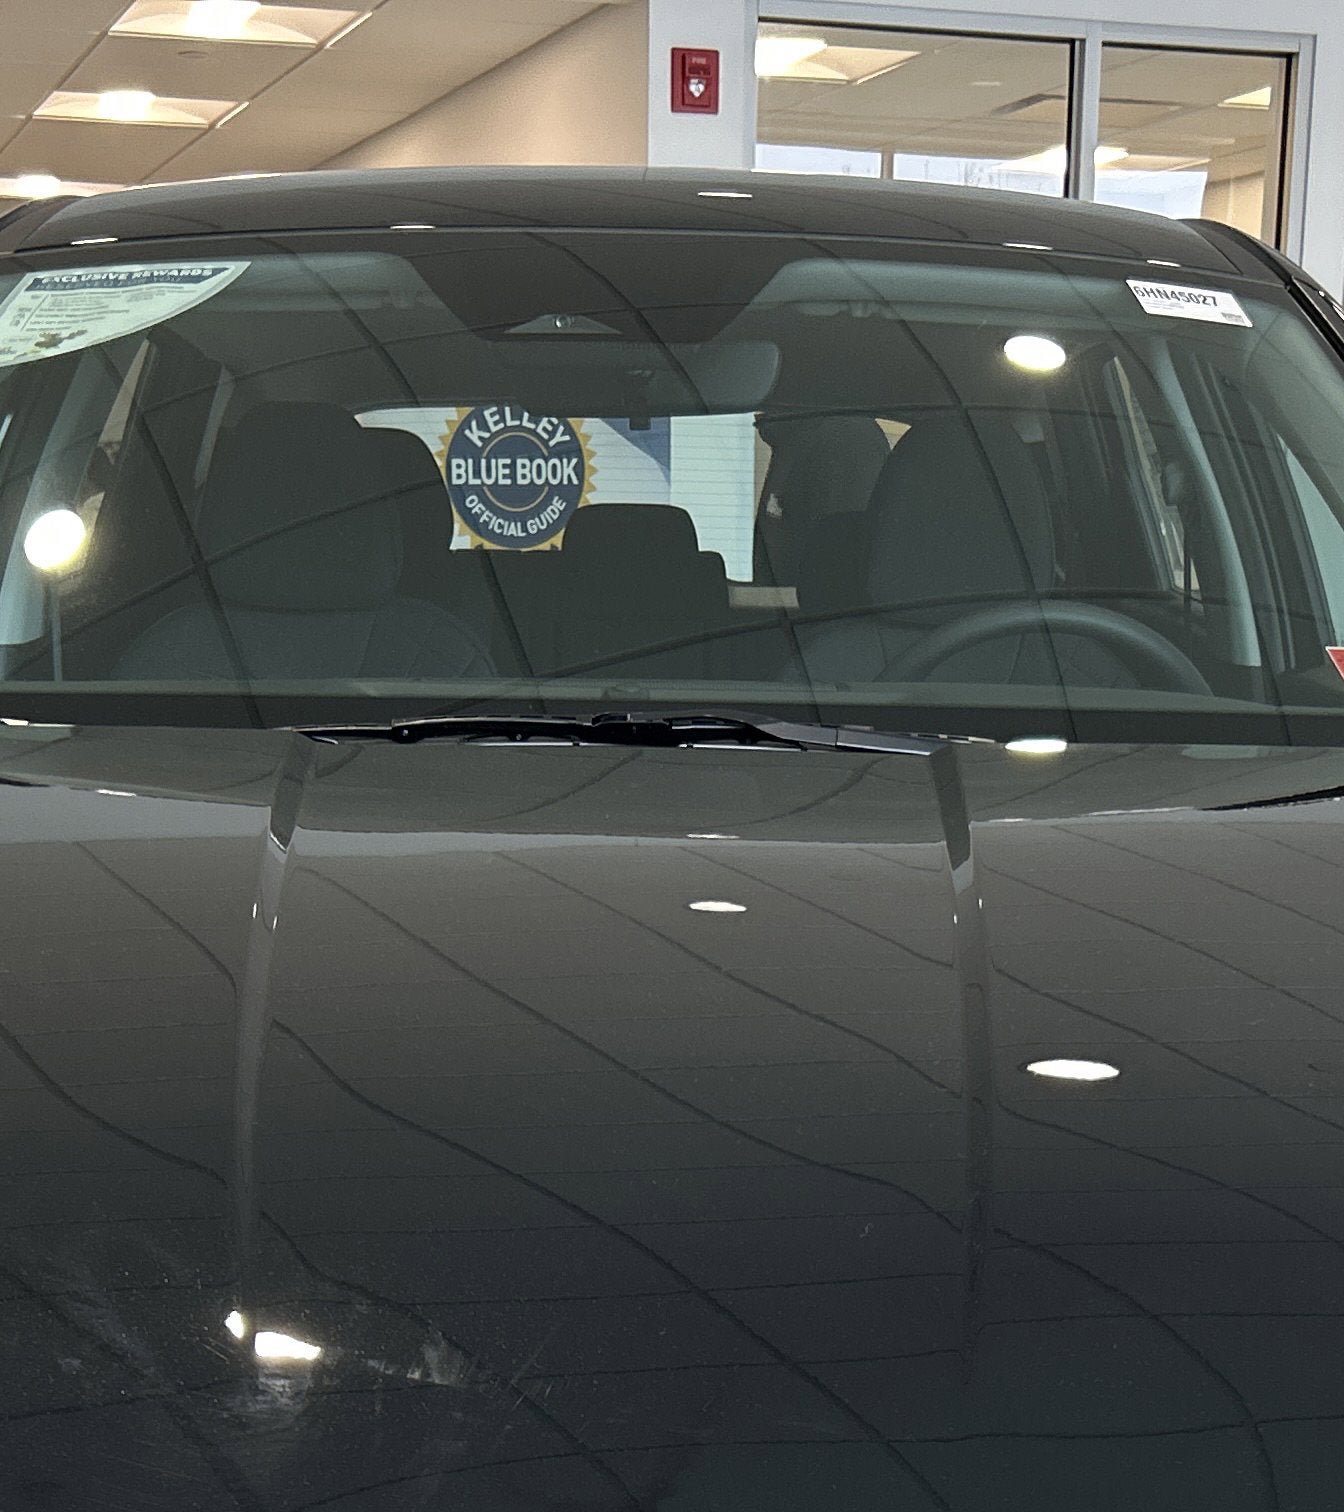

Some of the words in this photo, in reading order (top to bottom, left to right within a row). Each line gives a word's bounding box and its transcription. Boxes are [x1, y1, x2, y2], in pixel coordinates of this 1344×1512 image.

[131, 268, 213, 280] REWARDS
[1133, 286, 1218, 307] 6HN45027
[464, 406, 571, 448] KELLEY
[451, 457, 512, 485] BLUE
[516, 457, 579, 485] BOOK
[465, 494, 527, 537] OFFICIAL
[527, 496, 567, 535] GUIDE
